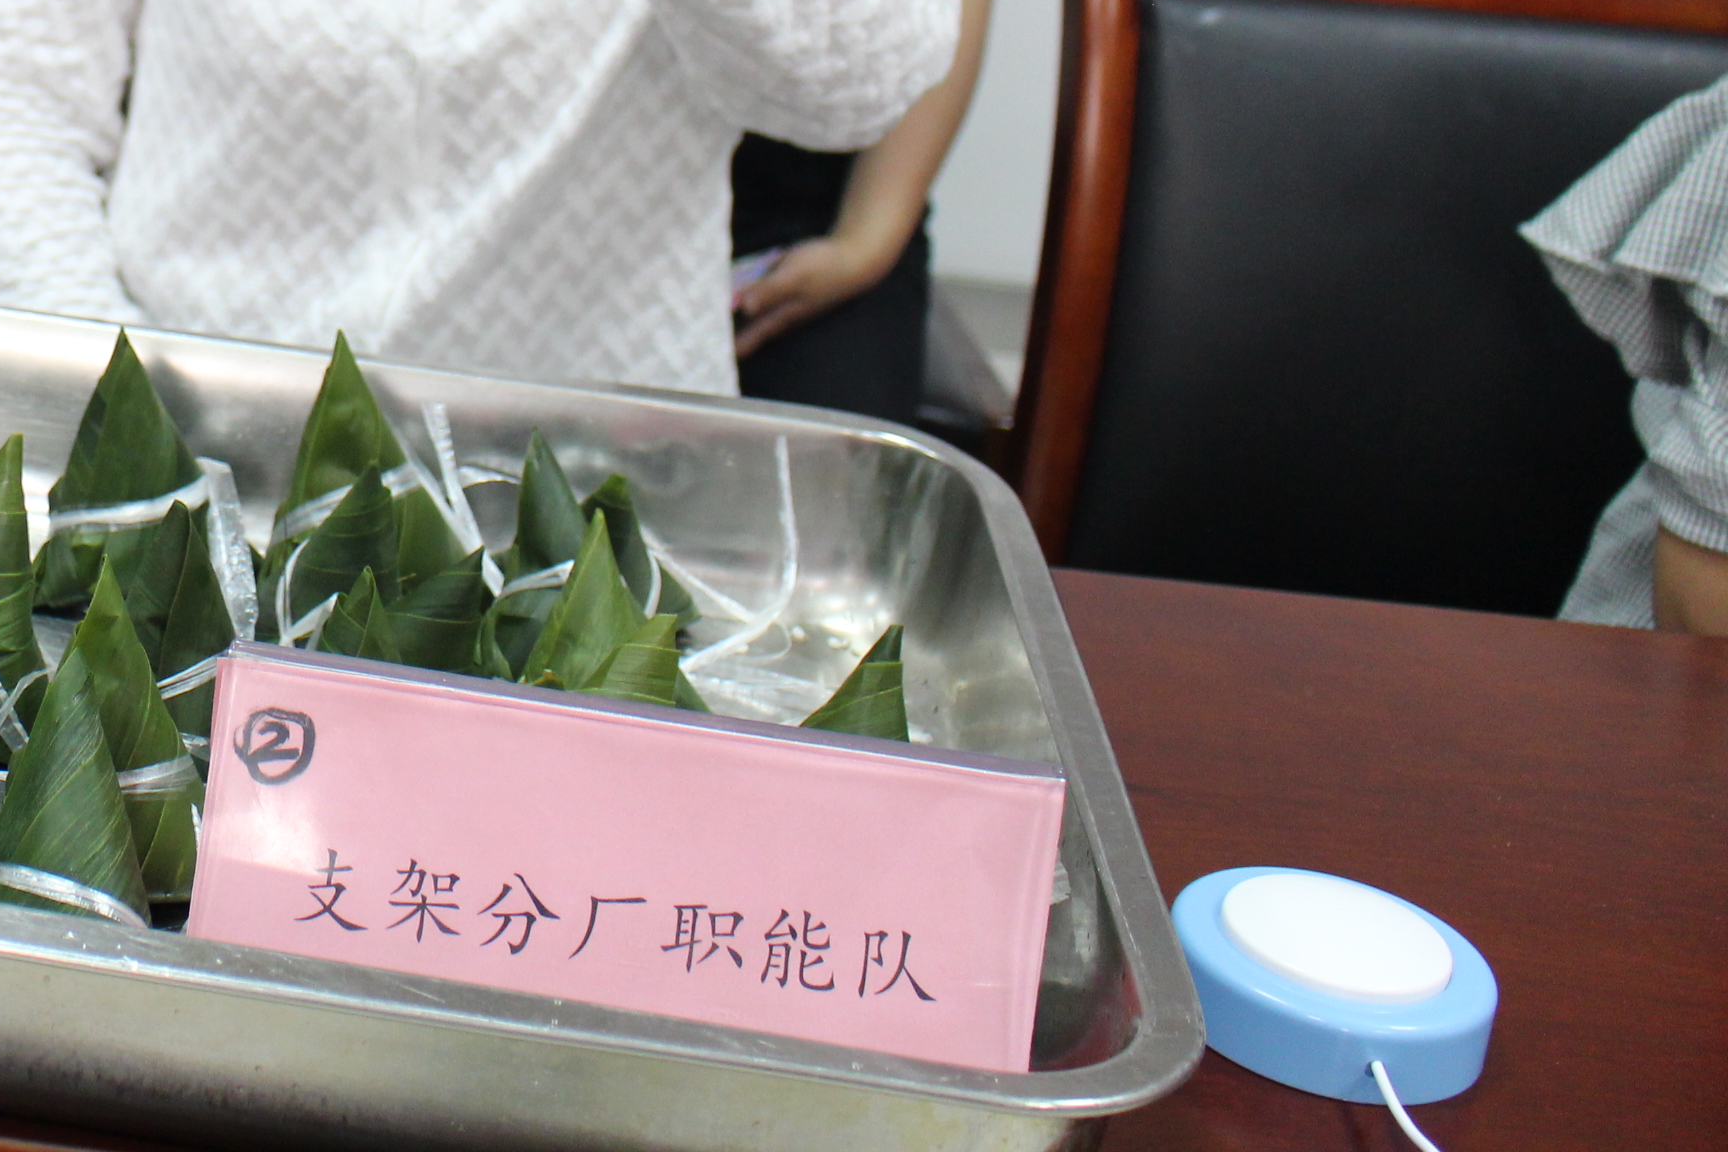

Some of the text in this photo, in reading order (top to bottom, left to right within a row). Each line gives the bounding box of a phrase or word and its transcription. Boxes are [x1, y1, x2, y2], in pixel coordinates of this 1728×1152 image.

[295, 849, 937, 1004] 支架分厂职能队
